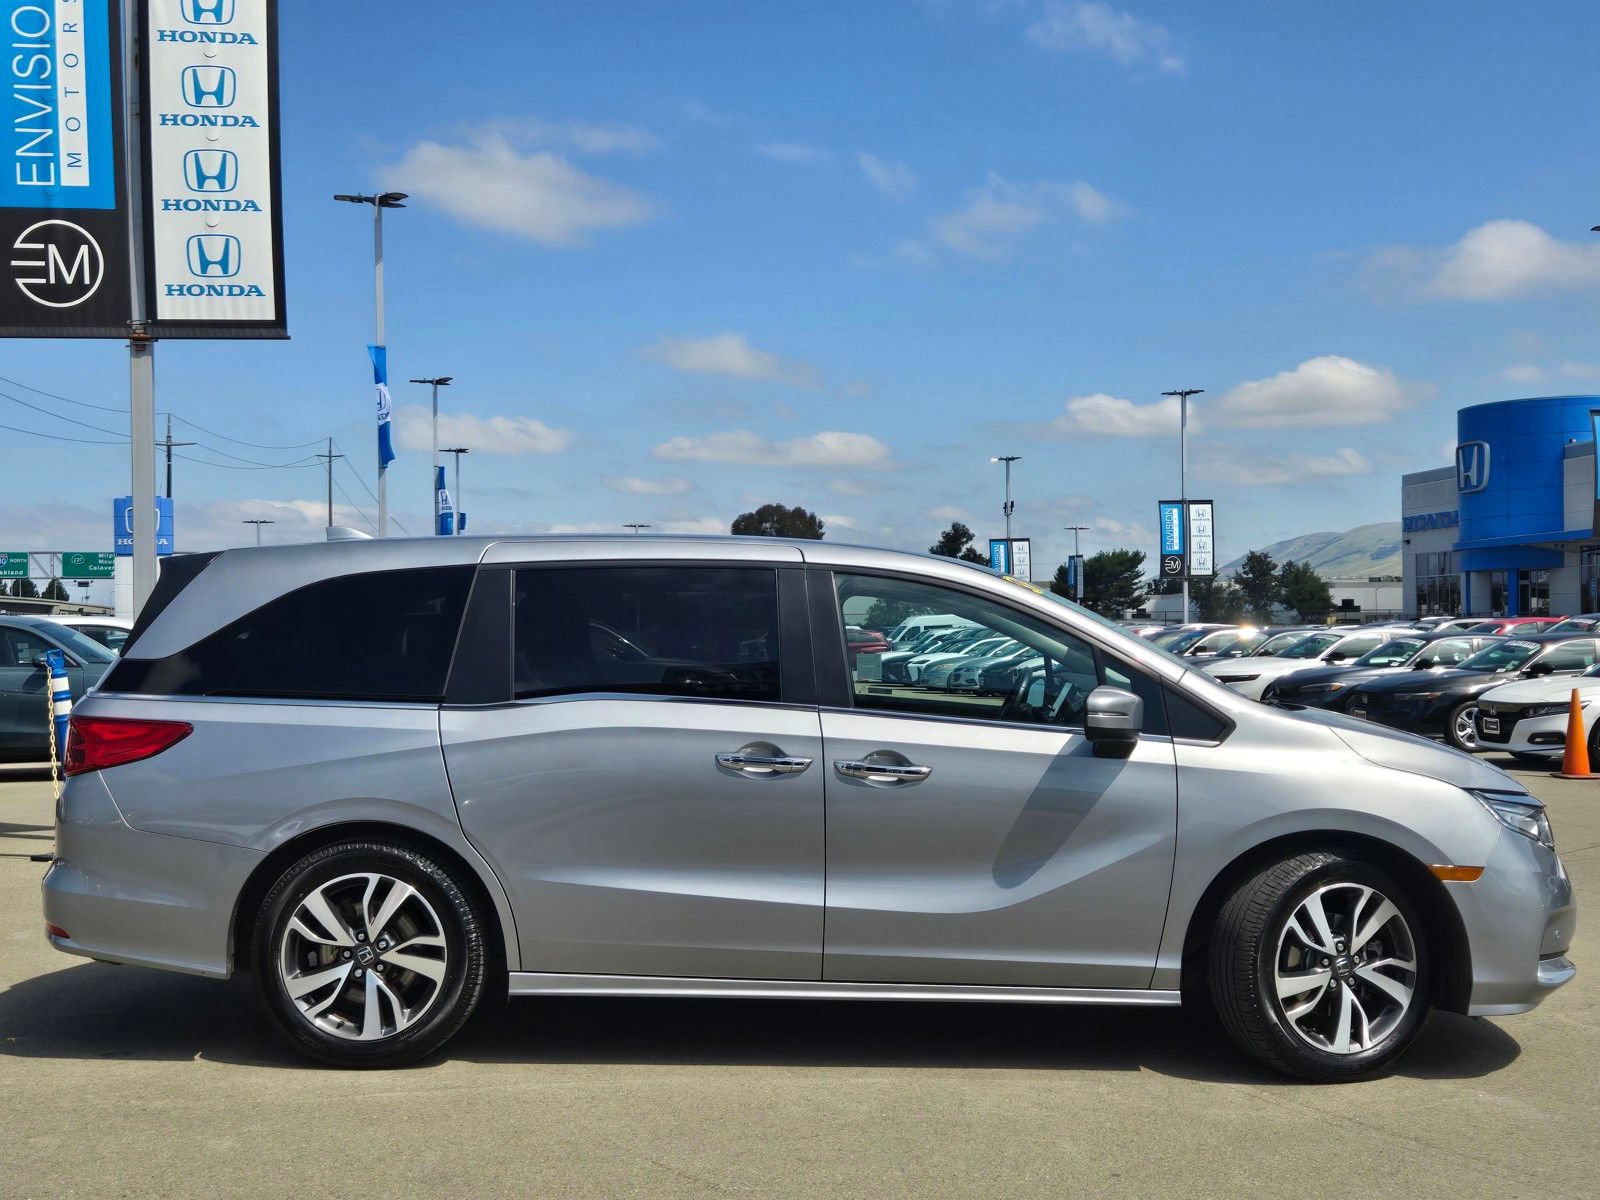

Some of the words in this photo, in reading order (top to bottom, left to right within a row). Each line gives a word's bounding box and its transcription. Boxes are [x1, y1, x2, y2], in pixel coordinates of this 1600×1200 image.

[157, 30, 258, 45] HONDA
[62, 0, 83, 168] MOTOR
[159, 114, 260, 128] HONDA
[161, 199, 263, 212] HONDA
[164, 284, 266, 297] HONDA
[1165, 507, 1174, 551] ENVISION
